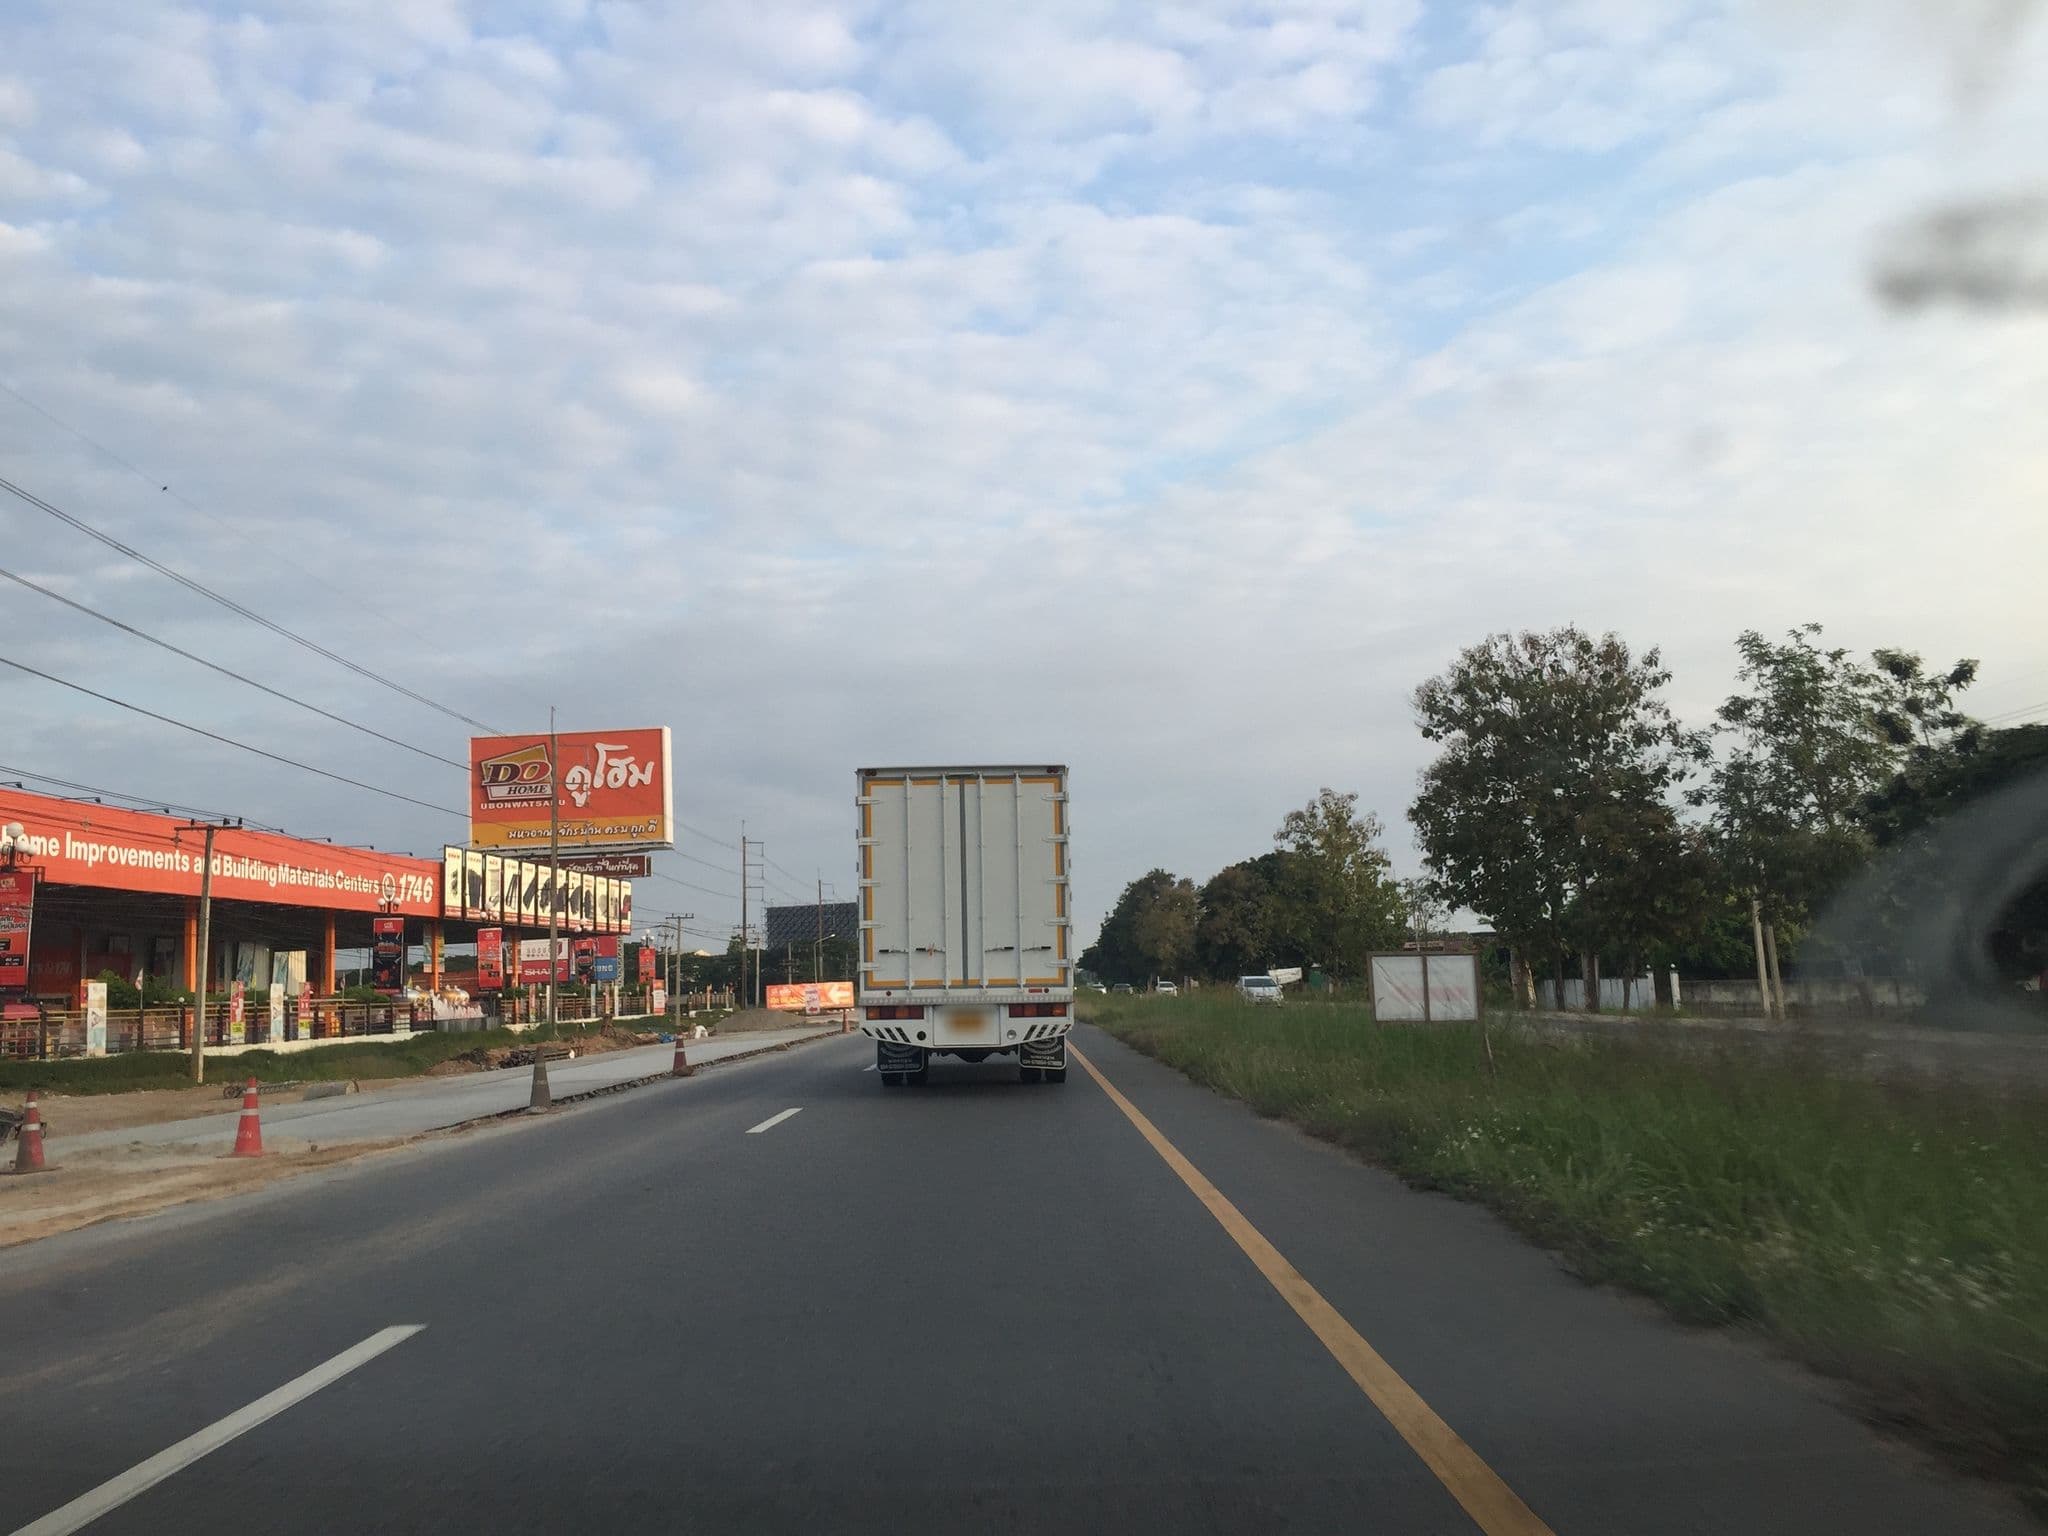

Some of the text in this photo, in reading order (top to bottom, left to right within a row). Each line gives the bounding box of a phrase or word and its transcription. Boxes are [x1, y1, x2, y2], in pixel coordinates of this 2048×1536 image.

[483, 760, 552, 786] DO
[506, 785, 549, 796] HOME
[480, 800, 566, 810] UBONWATSAU
[65, 831, 190, 874] Improvements
[193, 853, 222, 876] ad
[223, 855, 277, 887] Building
[278, 862, 335, 889] Materials
[335, 870, 380, 894] Centers
[400, 873, 434, 903] 1746
[523, 967, 564, 976] SHAP
